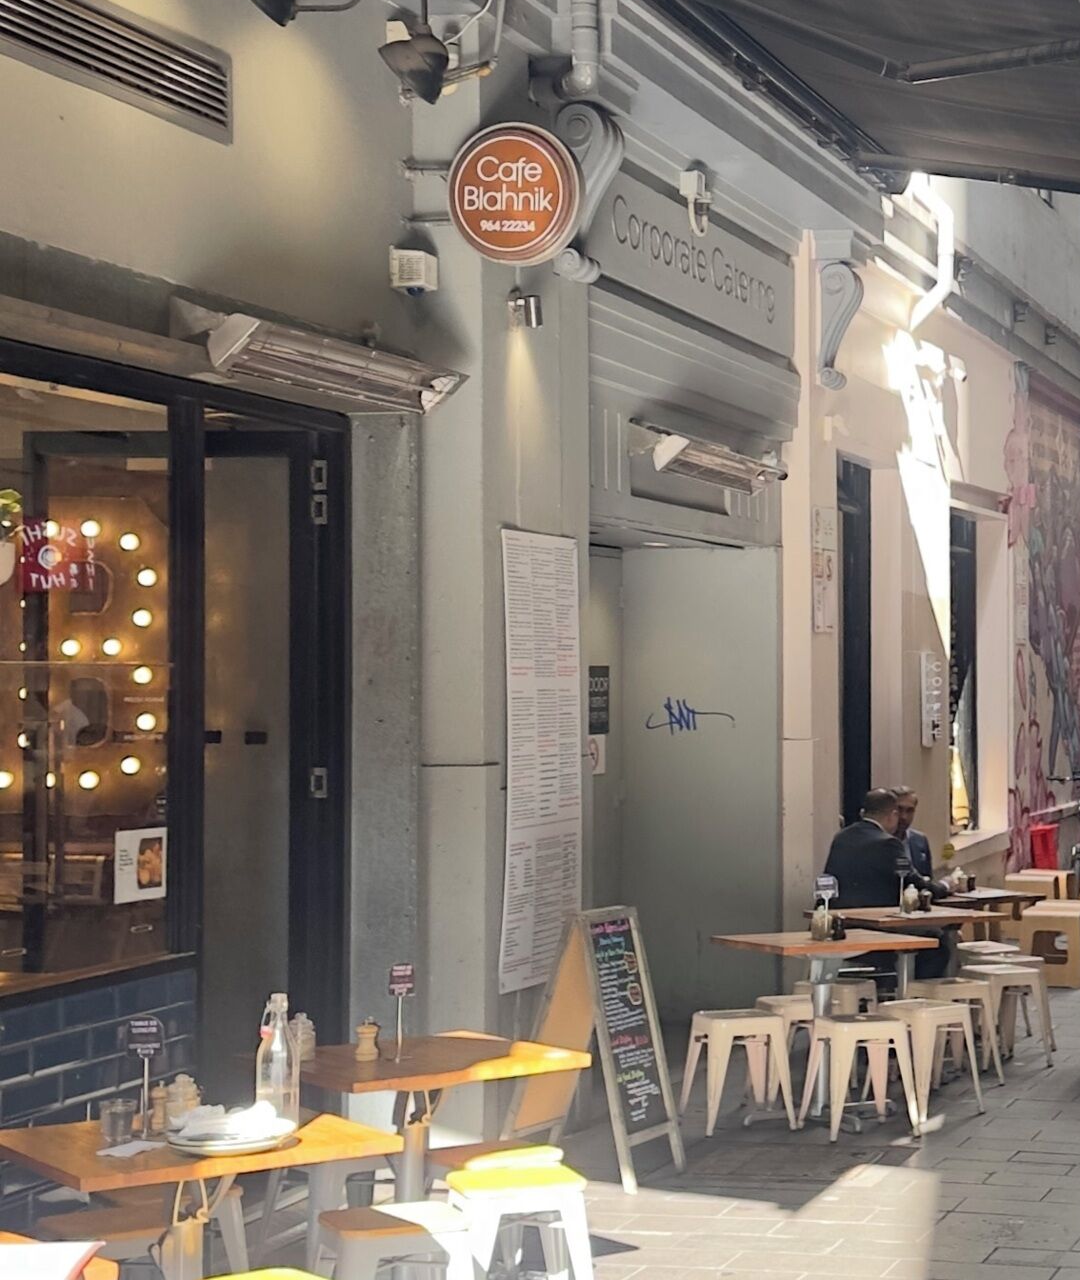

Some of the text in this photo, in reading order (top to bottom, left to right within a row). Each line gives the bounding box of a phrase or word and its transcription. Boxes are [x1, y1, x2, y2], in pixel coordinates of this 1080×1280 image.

[476, 155, 543, 188] Cafe
[463, 183, 554, 212] Blahnik
[611, 194, 708, 283] Corporate
